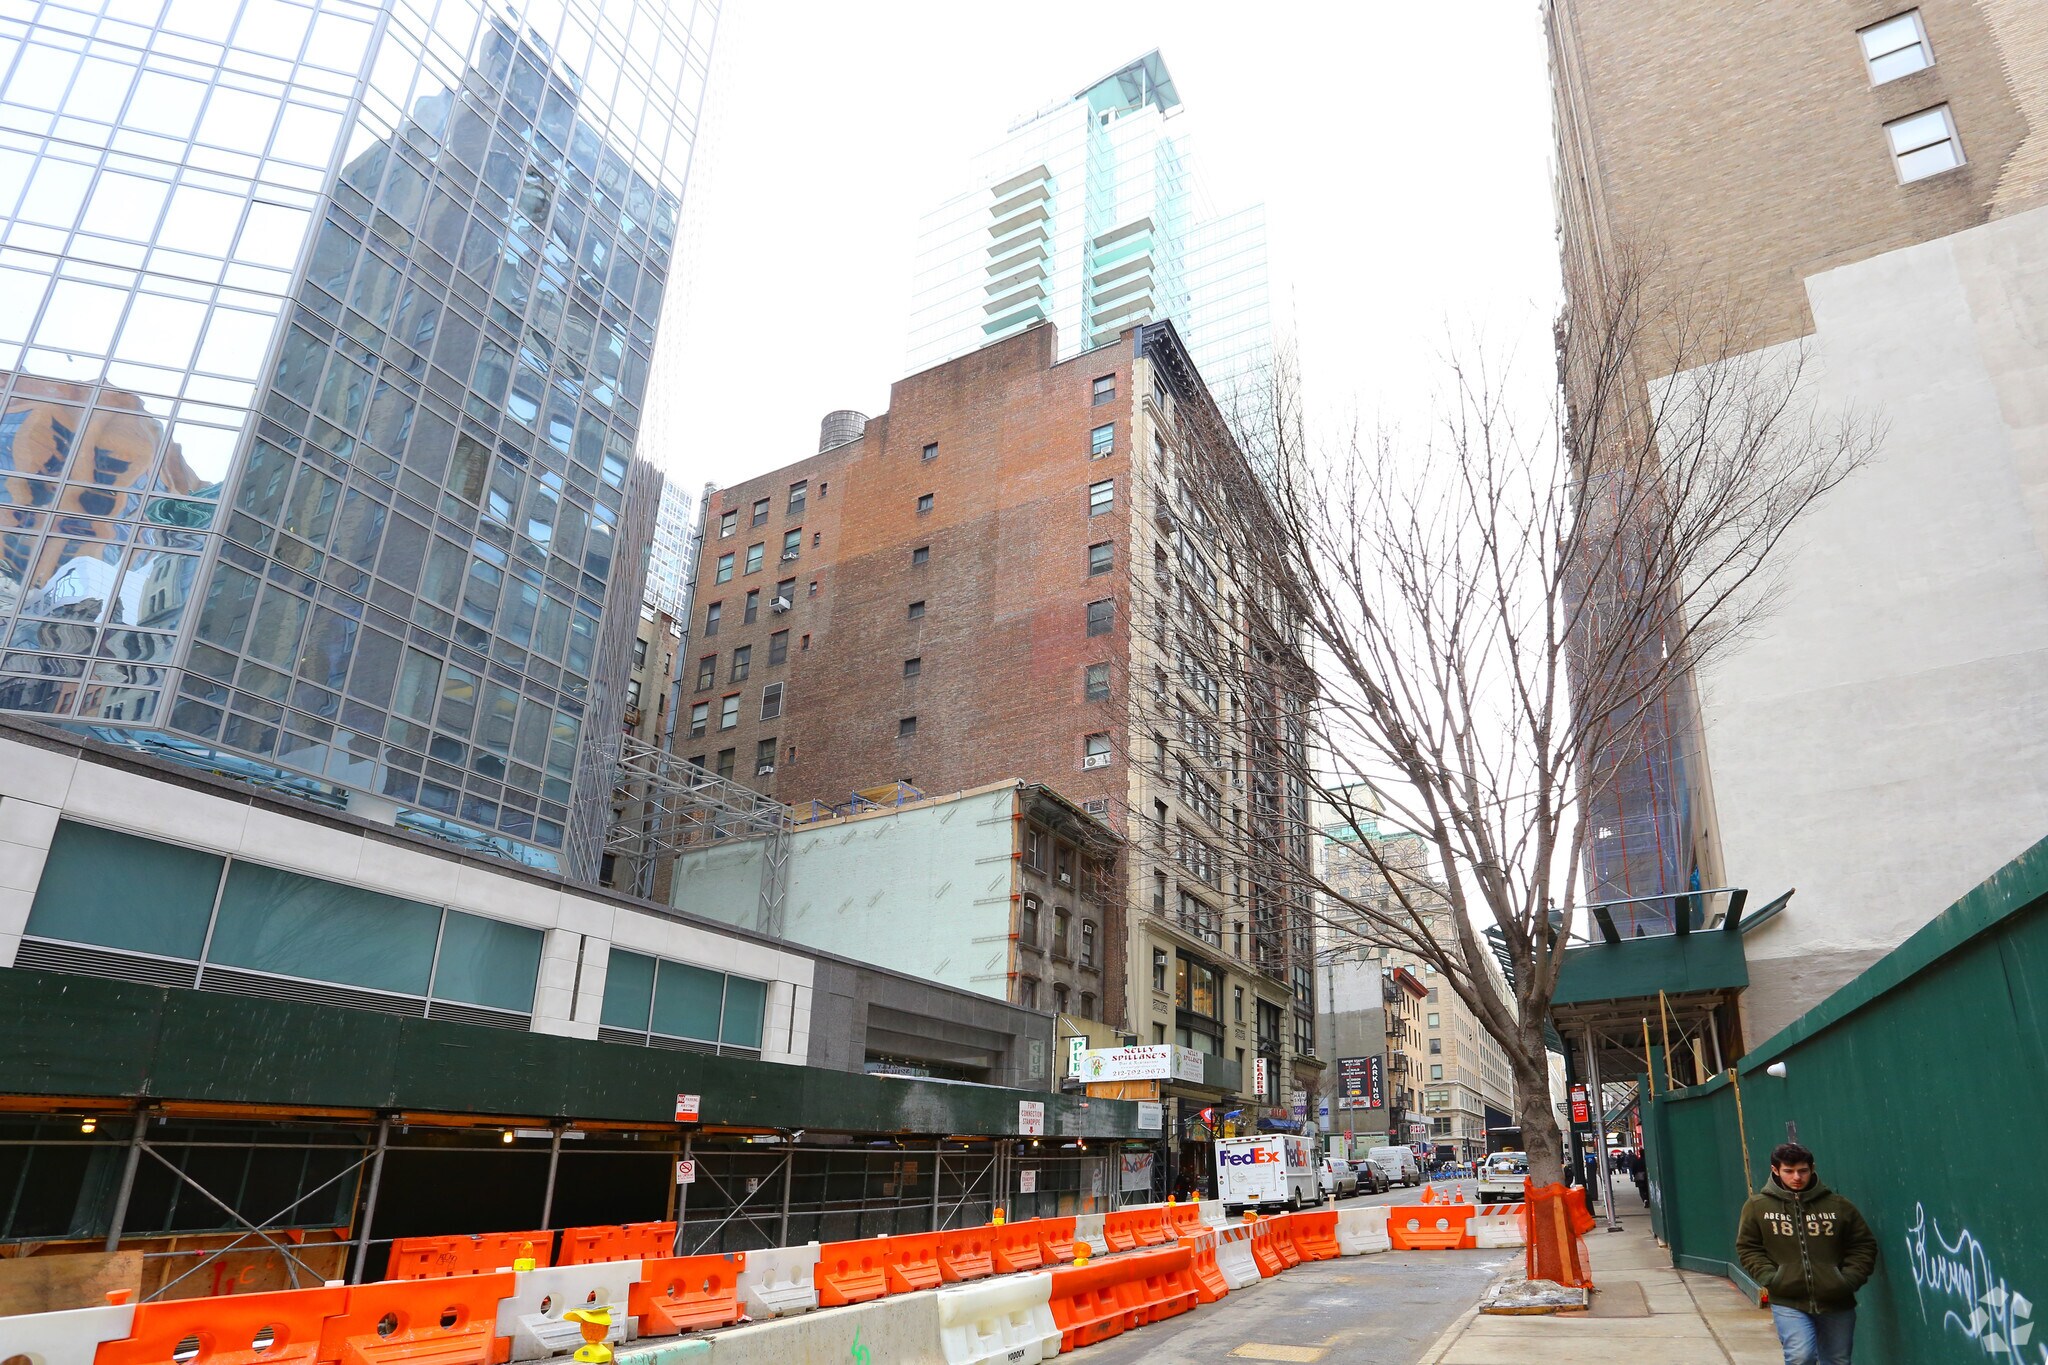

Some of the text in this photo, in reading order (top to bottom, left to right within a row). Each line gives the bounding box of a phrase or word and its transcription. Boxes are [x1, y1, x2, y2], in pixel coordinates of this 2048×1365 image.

[1112, 1052, 1167, 1061] SPILLANE'S
[1256, 1058, 1264, 1094] CLEANERS
[1371, 1058, 1380, 1099] PARKING
[1219, 1147, 1280, 1167] FedEx
[1284, 1139, 1308, 1168] FedEx
[1008, 1349, 1025, 1361] YODOCK
